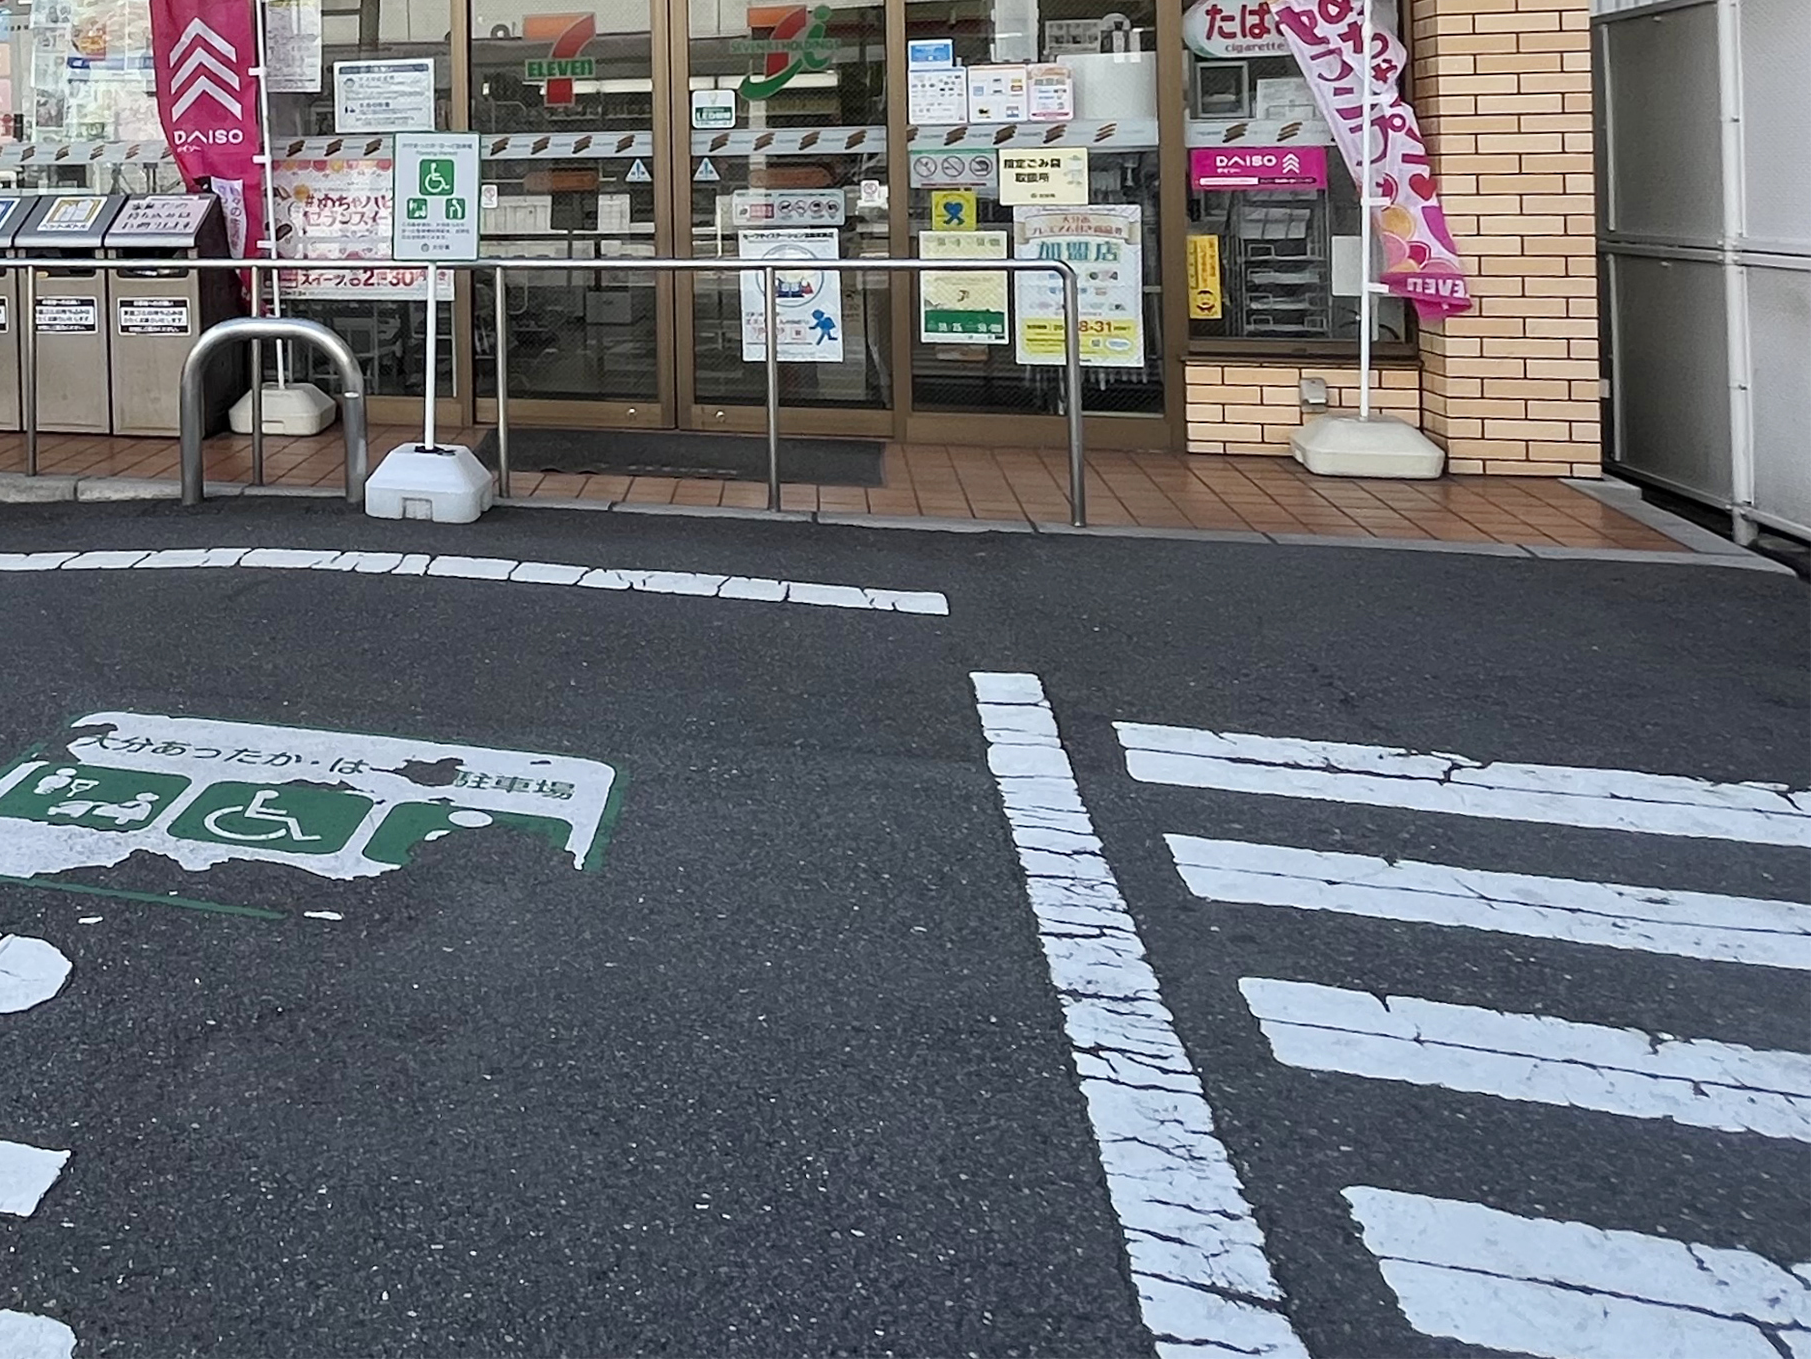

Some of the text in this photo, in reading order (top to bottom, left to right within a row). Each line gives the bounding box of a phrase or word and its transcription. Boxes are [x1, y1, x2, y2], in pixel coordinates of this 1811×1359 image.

[1205, 2, 1286, 40] たば
[1225, 43, 1285, 53] cigarette
[173, 129, 244, 145] DAISO
[1216, 155, 1277, 167] DAISO
[1038, 241, 1119, 261] 加盟店
[80, 734, 576, 801] 大分あったか・はー駐車場
